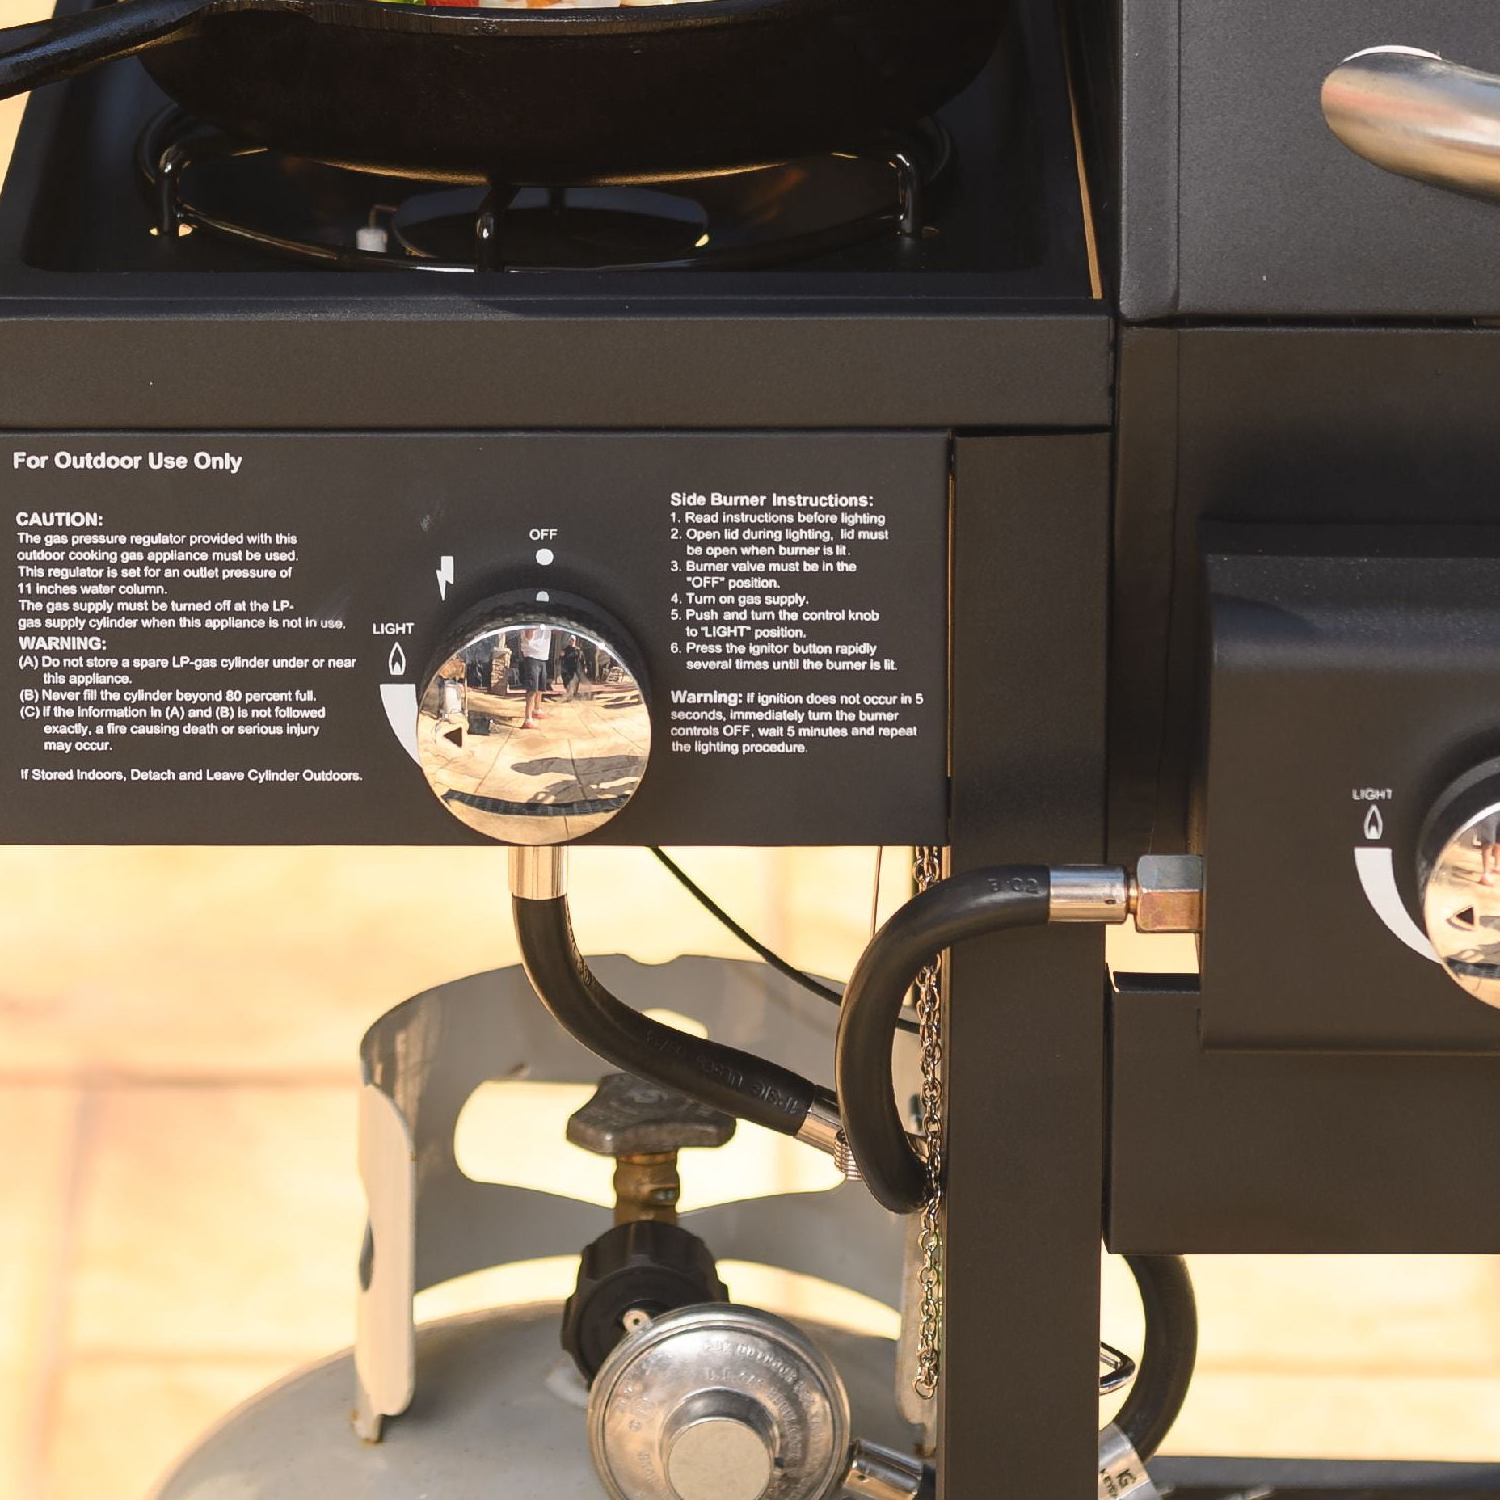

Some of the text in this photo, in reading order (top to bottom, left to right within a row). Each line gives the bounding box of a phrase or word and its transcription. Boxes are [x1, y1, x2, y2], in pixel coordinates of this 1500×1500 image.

[13, 451, 242, 474] For Outdoor Use Only
[670, 491, 873, 508] Side Burner Instructions:
[15, 511, 103, 527] CAUTION:
[670, 511, 885, 526] 1. Read instructions before lighting
[16, 532, 297, 547] The gas pressure regulator provided with this
[528, 528, 557, 540] OFF
[670, 527, 888, 542] 2. Open lid during lighting, lid must
[16, 549, 298, 564] outdoor cooking gas appliance must be used.
[686, 544, 850, 558] be open when burner is lit.
[17, 565, 292, 580] This regulator is set for an outlet pressure of
[670, 560, 857, 572] 3. Burner valve must be in the
[728, 576, 780, 591] position.
[670, 592, 808, 607] 4. Turn on gas supply.
[372, 622, 415, 634] LIGHT
[18, 635, 106, 651] WARNING:
[18, 655, 356, 670] (A) Do not store a spare LP-gas cylinder under or near
[43, 671, 132, 687] this appliance.
[670, 689, 923, 707] Warning: If ignition does not occur in 5
[20, 768, 362, 783] If Stored Indoors, Detach and Leave Cylinder Outdoors.
[1352, 787, 1392, 800] LIGHT
